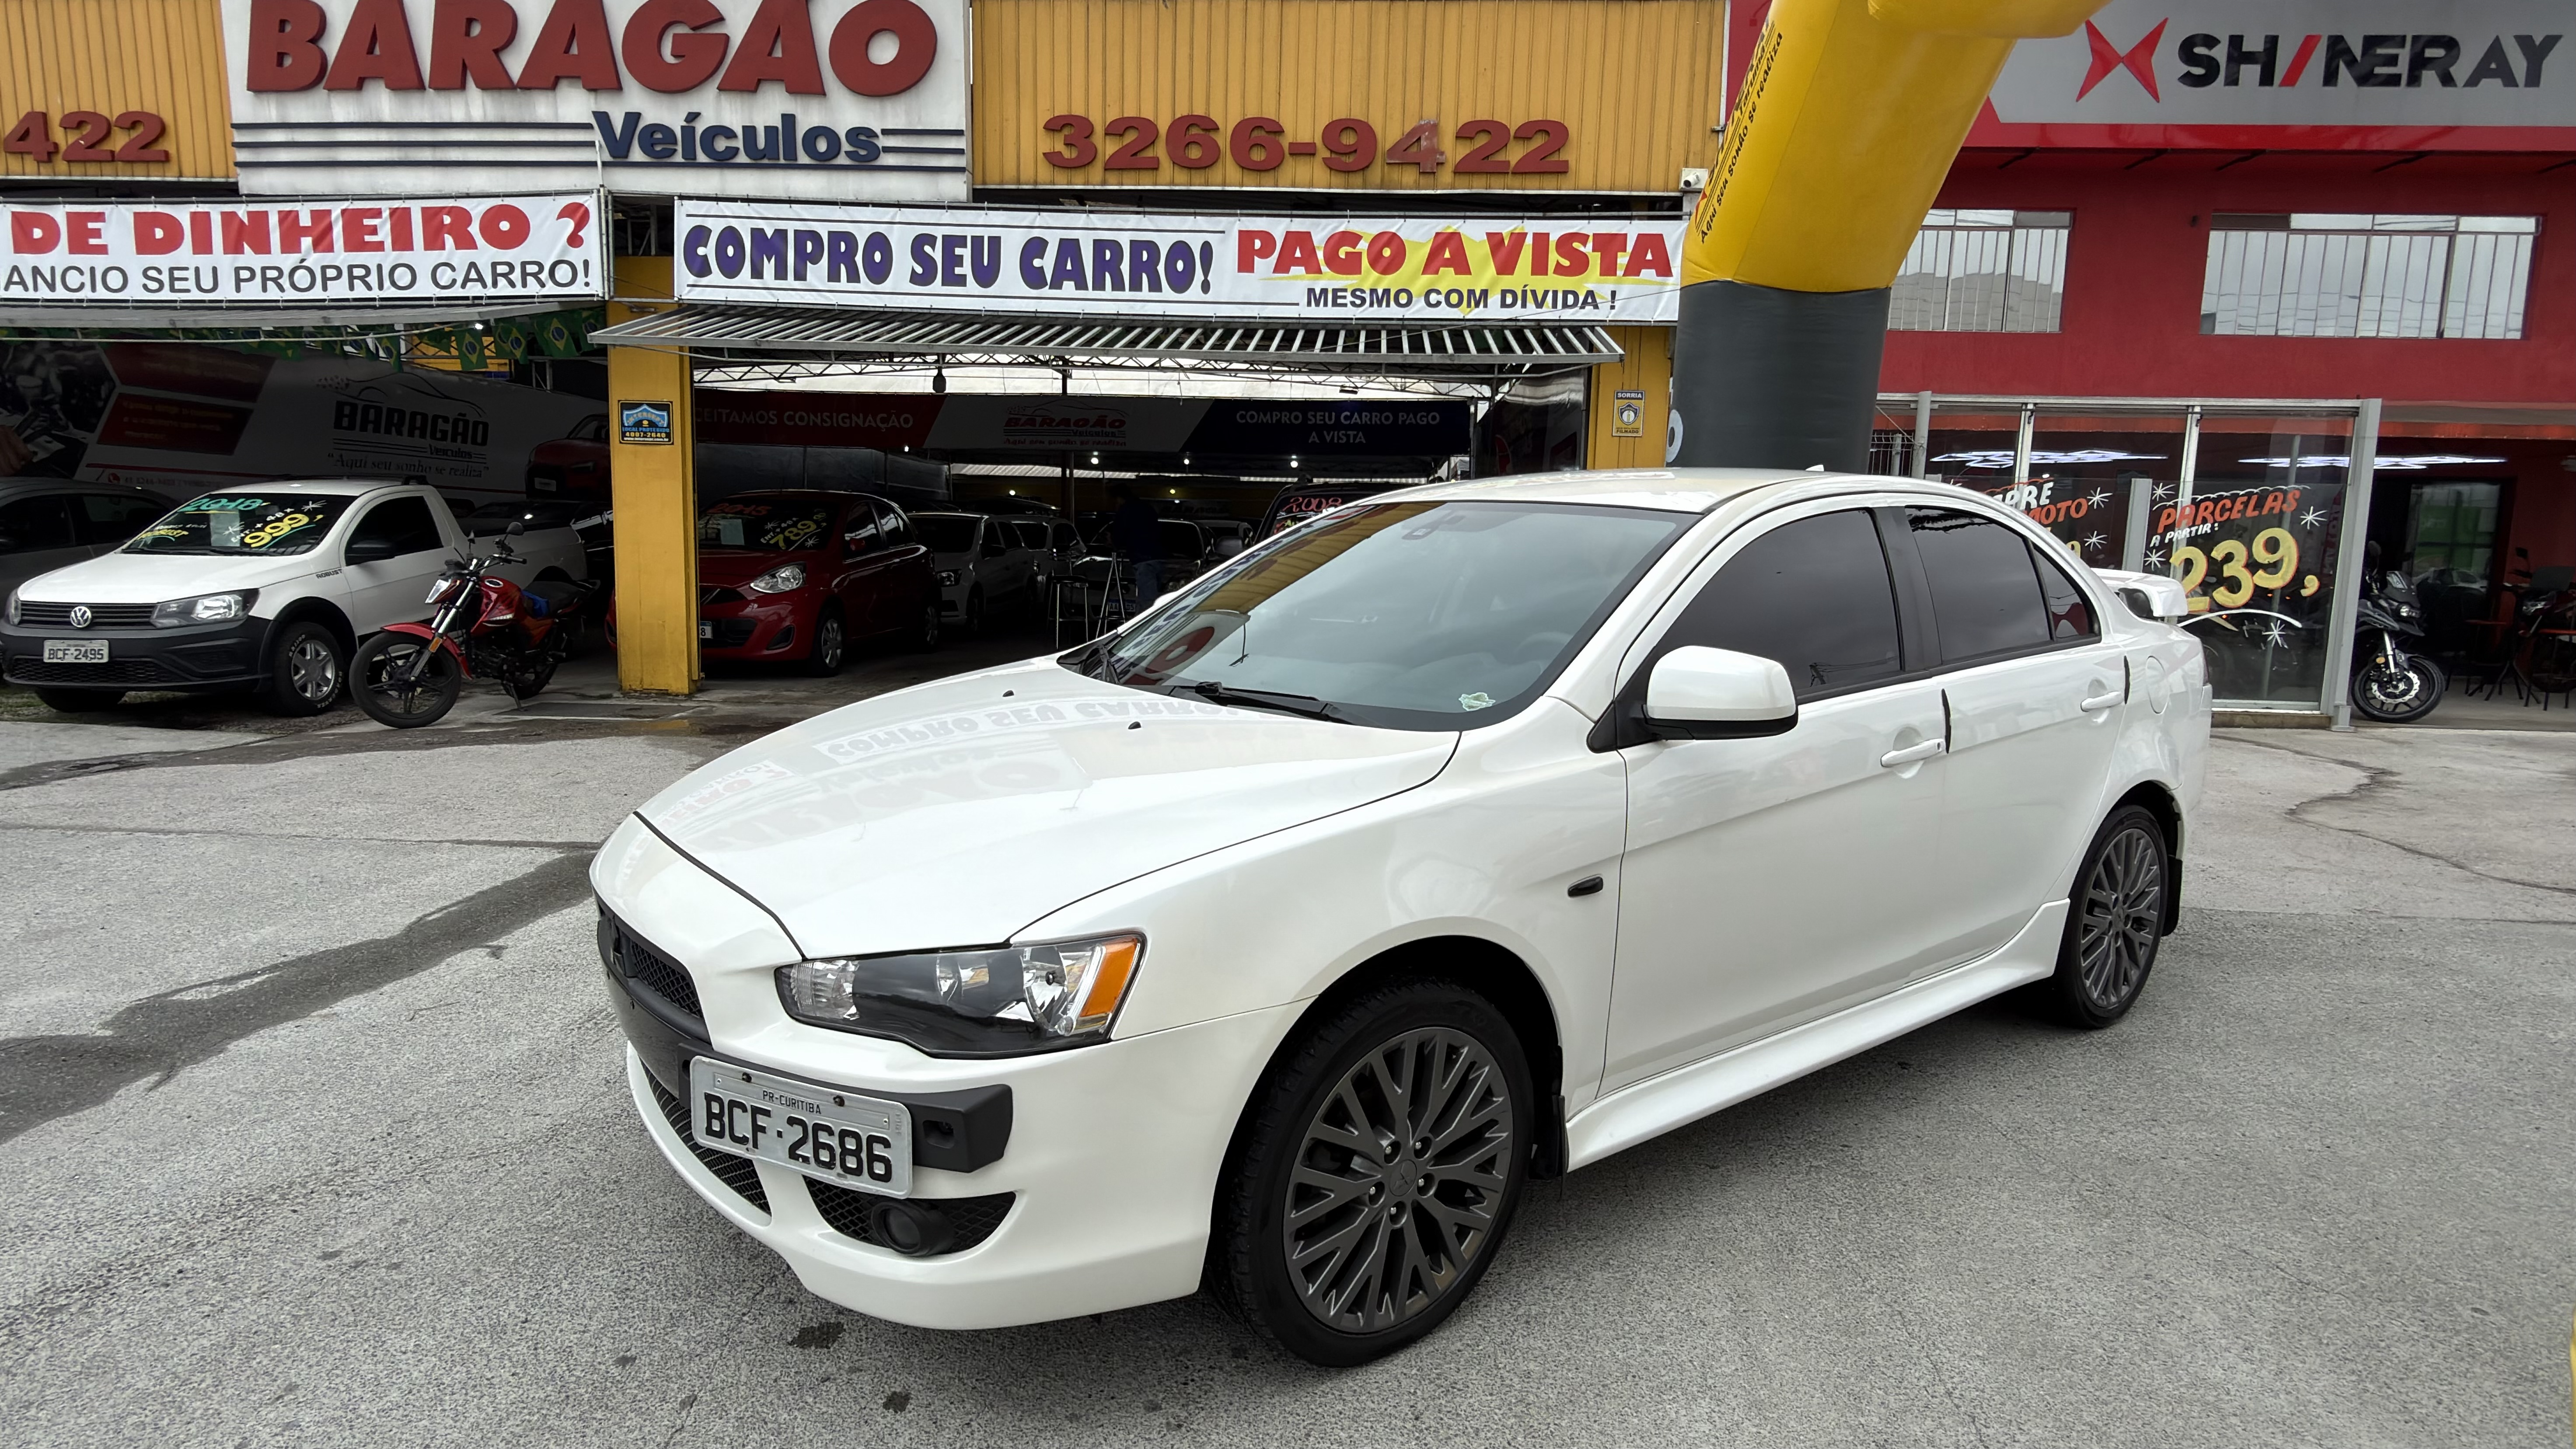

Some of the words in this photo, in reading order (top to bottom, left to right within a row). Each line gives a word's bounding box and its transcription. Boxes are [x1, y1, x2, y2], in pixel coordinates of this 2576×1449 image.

[2177, 33, 2563, 87] SHINERAY
[3, 111, 170, 163] 422
[592, 111, 881, 162] Veículos
[1042, 114, 1570, 173] 3266-9422
[1701, 204, 1717, 244] Aqui
[1717, 178, 1728, 206] seu
[1728, 125, 1748, 177] sonho
[1749, 101, 1756, 123] se
[1757, 32, 1782, 99] realiza
[10, 211, 109, 255] DE
[133, 204, 531, 256] DINHEIRO
[3, 264, 129, 294] ANCIO
[142, 264, 220, 294] SEU
[234, 258, 418, 293] PRÓPRIO
[430, 258, 592, 291] CARRO!
[683, 224, 893, 285] COMPRO
[910, 233, 1002, 289] SEU
[1019, 236, 1213, 295] CARRO!
[1238, 230, 1407, 276] PAGO
[1421, 232, 1472, 276] A
[1486, 232, 1674, 278] VISTA
[1306, 287, 1413, 309] MESMO
[1424, 288, 1488, 310] COM
[1500, 285, 1600, 311] DÍVIDA
[334, 400, 489, 446] BARAGÃO
[783, 410, 914, 432] CONSIGNAÇÃO
[1236, 411, 1302, 424] COMPRO
[1307, 411, 1335, 425] SEU
[1340, 411, 1393, 425] CARRO
[1399, 412, 1440, 426] PAGO
[1309, 432, 1320, 443] A
[1323, 431, 1366, 443] VISTA
[177, 498, 264, 513] 2018
[2157, 489, 2301, 534] PARCELAS
[2150, 534, 2161, 548] A
[316, 569, 342, 579] ROBUST
[763, 1090, 822, 1115] PR-CURITIBA
